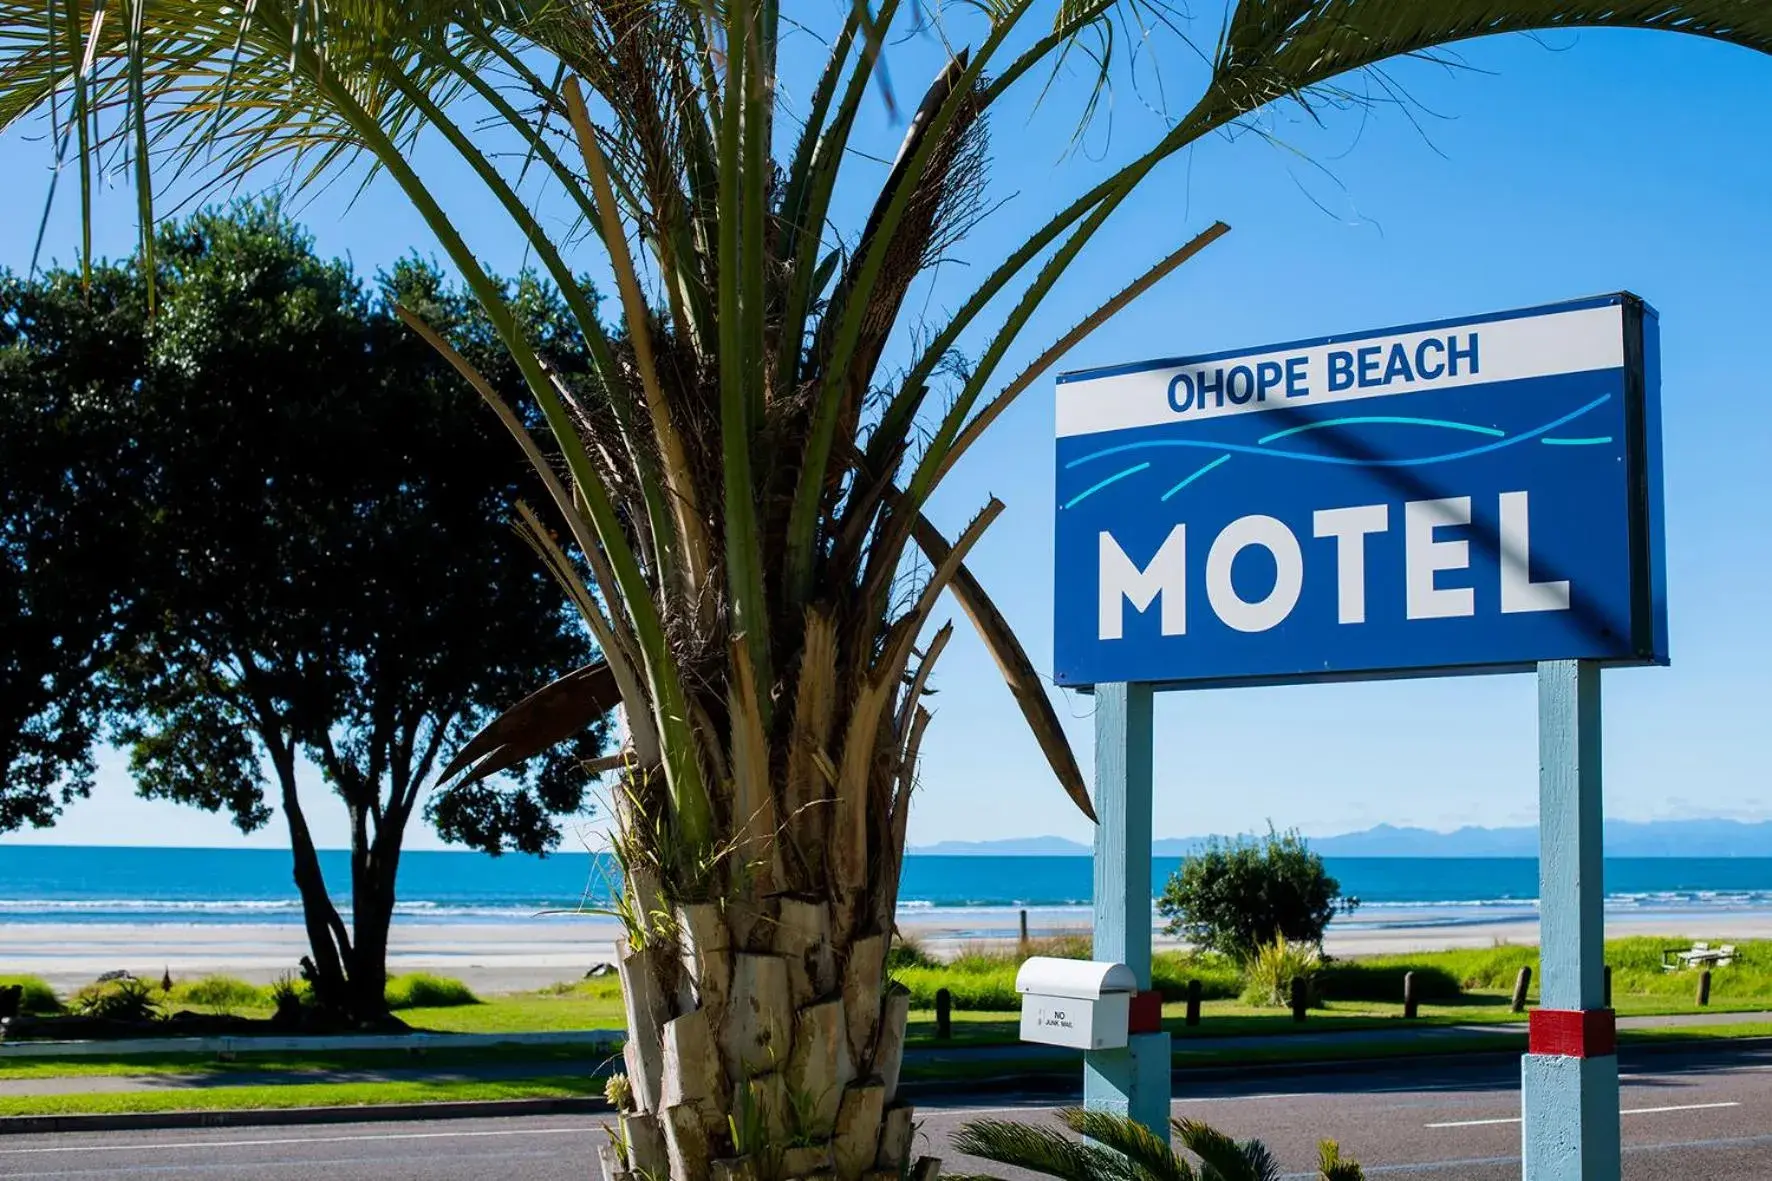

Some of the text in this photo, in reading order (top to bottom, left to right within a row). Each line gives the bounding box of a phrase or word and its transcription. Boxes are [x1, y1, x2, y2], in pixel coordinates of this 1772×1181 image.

[1167, 333, 1479, 412] OHOPE BEACH
[1099, 491, 1570, 640] MOTEL
[1054, 1011, 1065, 1020] NO
